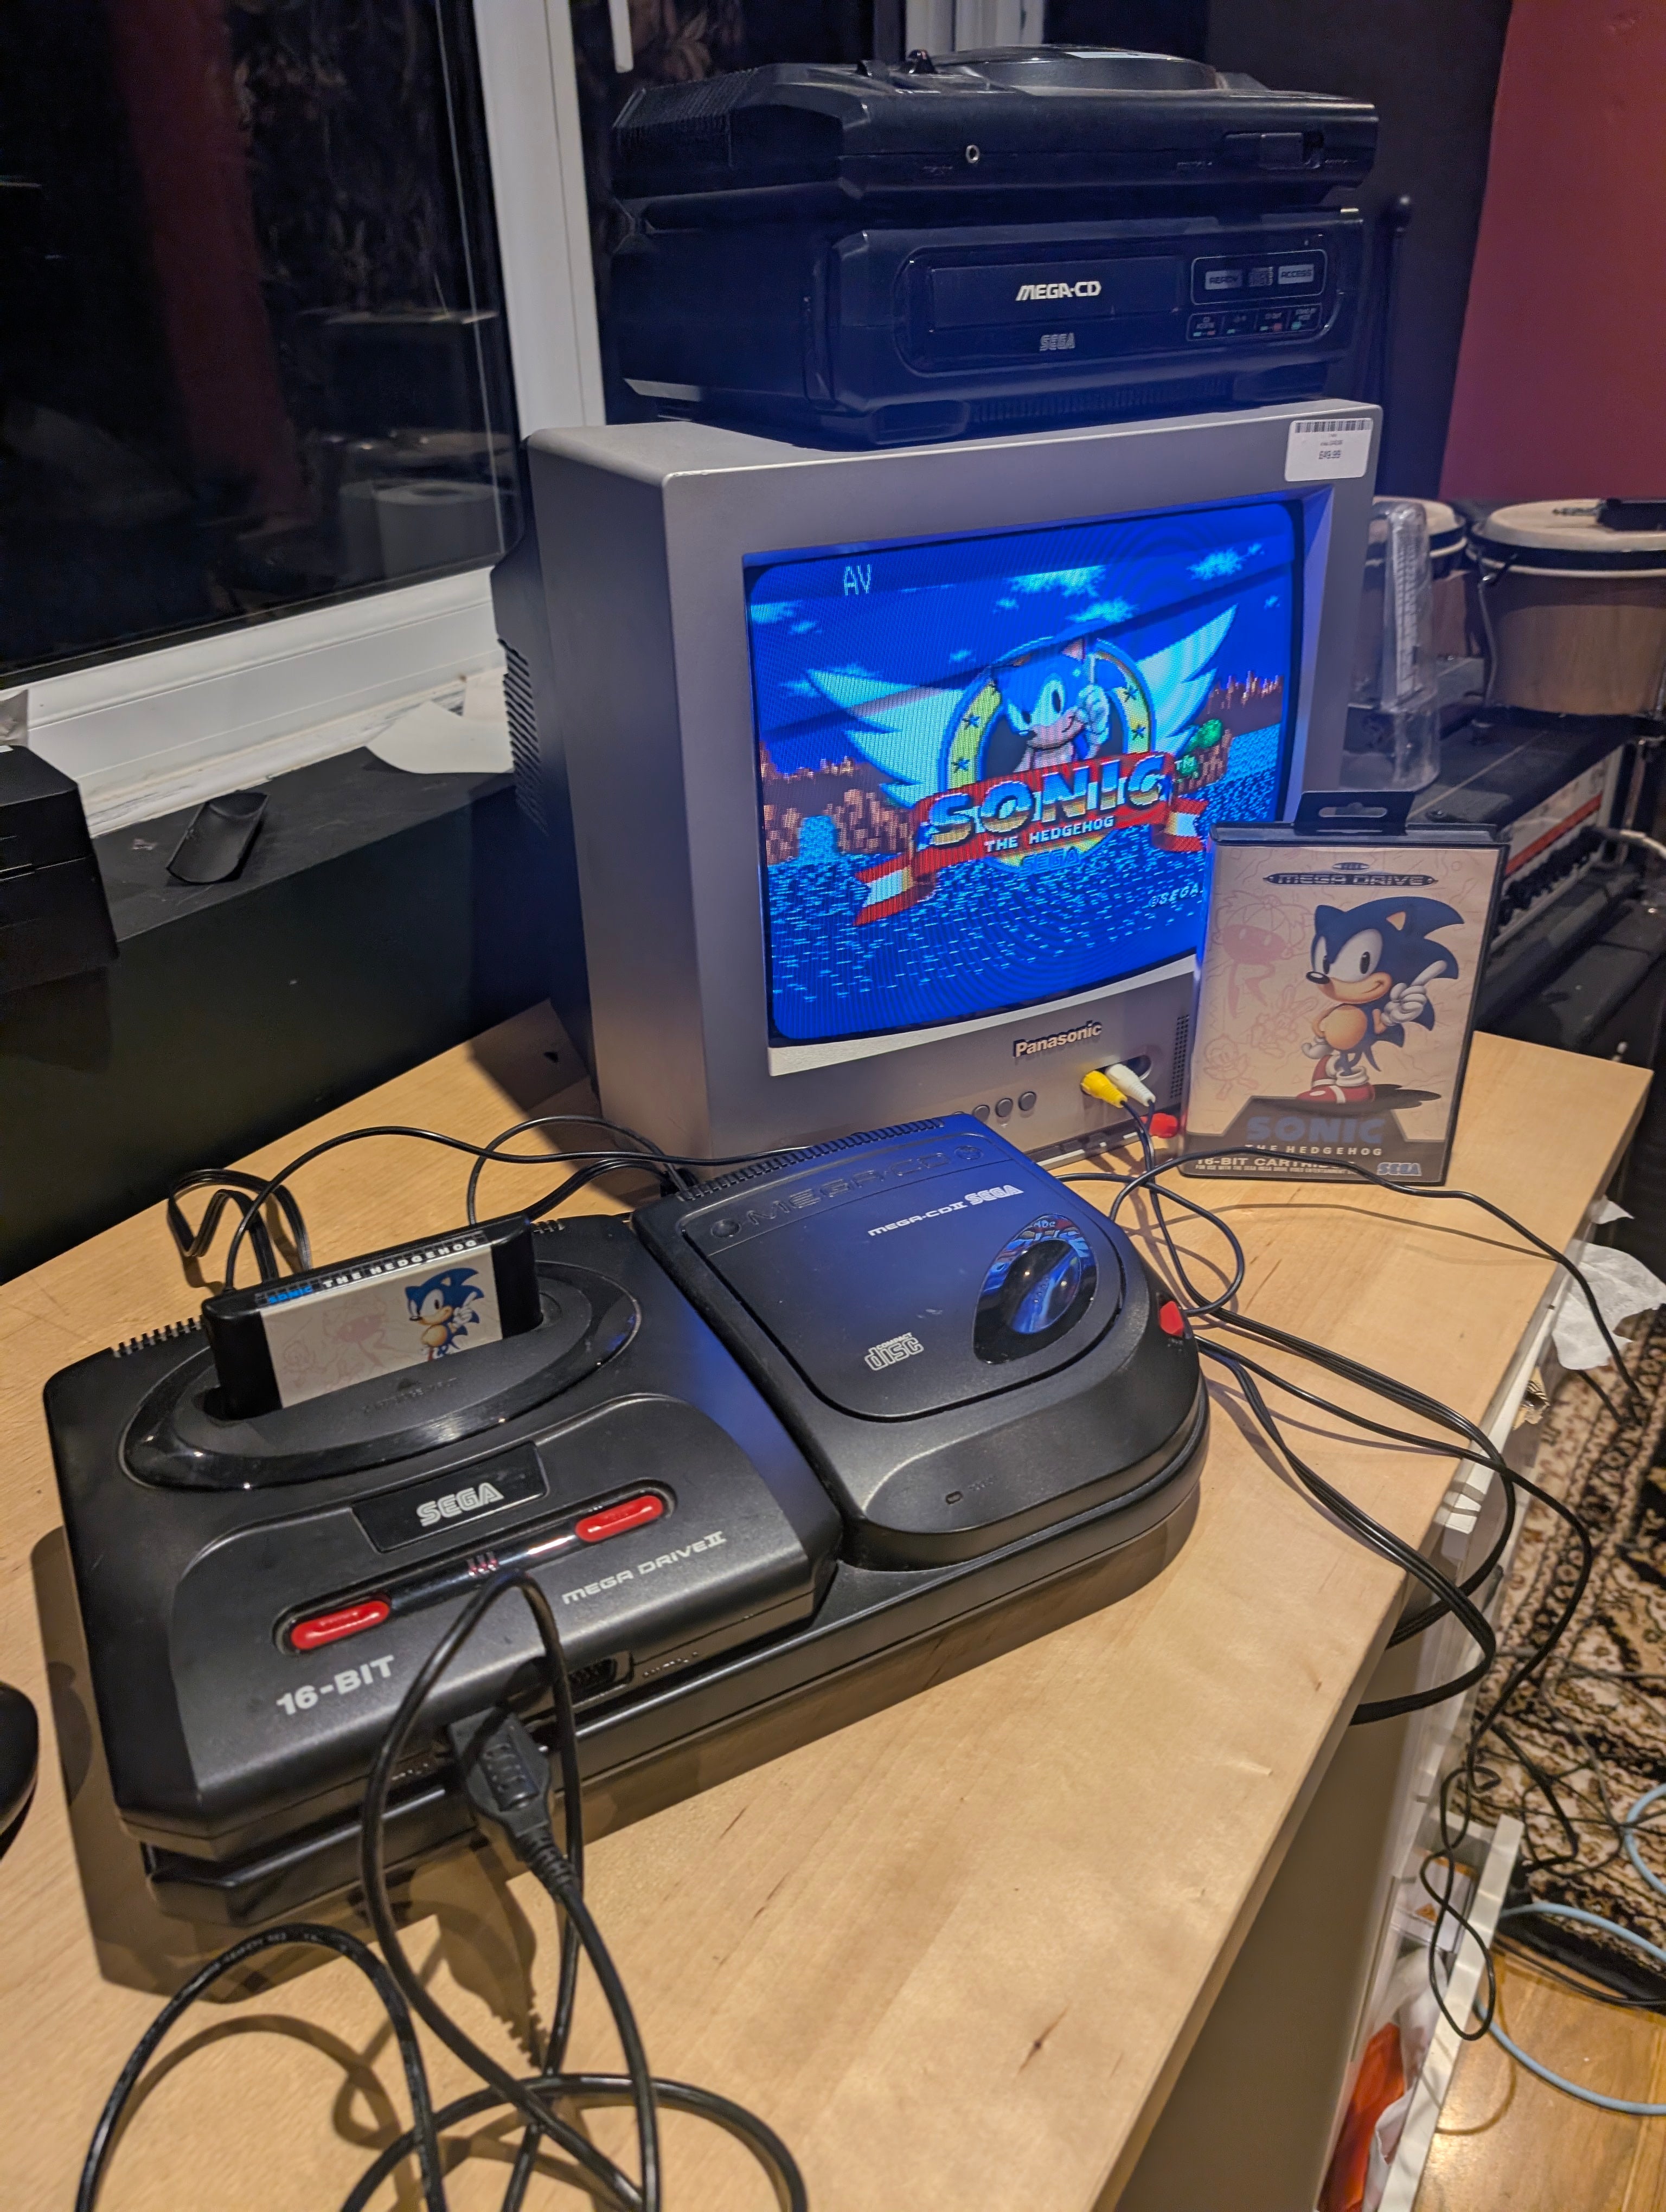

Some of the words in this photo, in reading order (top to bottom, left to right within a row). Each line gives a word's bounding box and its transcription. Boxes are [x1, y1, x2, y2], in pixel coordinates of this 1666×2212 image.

[1015, 281, 1101, 301] MEGA-CD
[1040, 332, 1075, 351] SEGA
[844, 564, 872, 595] AV
[925, 754, 1166, 847] SONIC
[984, 835, 1018, 853] THE
[1029, 815, 1115, 845] HEDGEHOG
[1278, 873, 1347, 885] MEGA
[1353, 874, 1424, 885] DRIVE
[1014, 1021, 1102, 1057] Panasonic
[1248, 1116, 1386, 1144] SONIC
[1286, 1146, 1383, 1156] HEDGEHOG
[1377, 1162, 1422, 1176] SEGA
[964, 1185, 1024, 1205] SEGA
[268, 1285, 313, 1304] SONIC
[323, 1272, 363, 1288] THE
[369, 1239, 477, 1275] HEDGEHOG
[415, 1482, 504, 1527] SEGA
[561, 1568, 635, 1605] MEGA
[276, 1654, 394, 1715] 16-BIT
